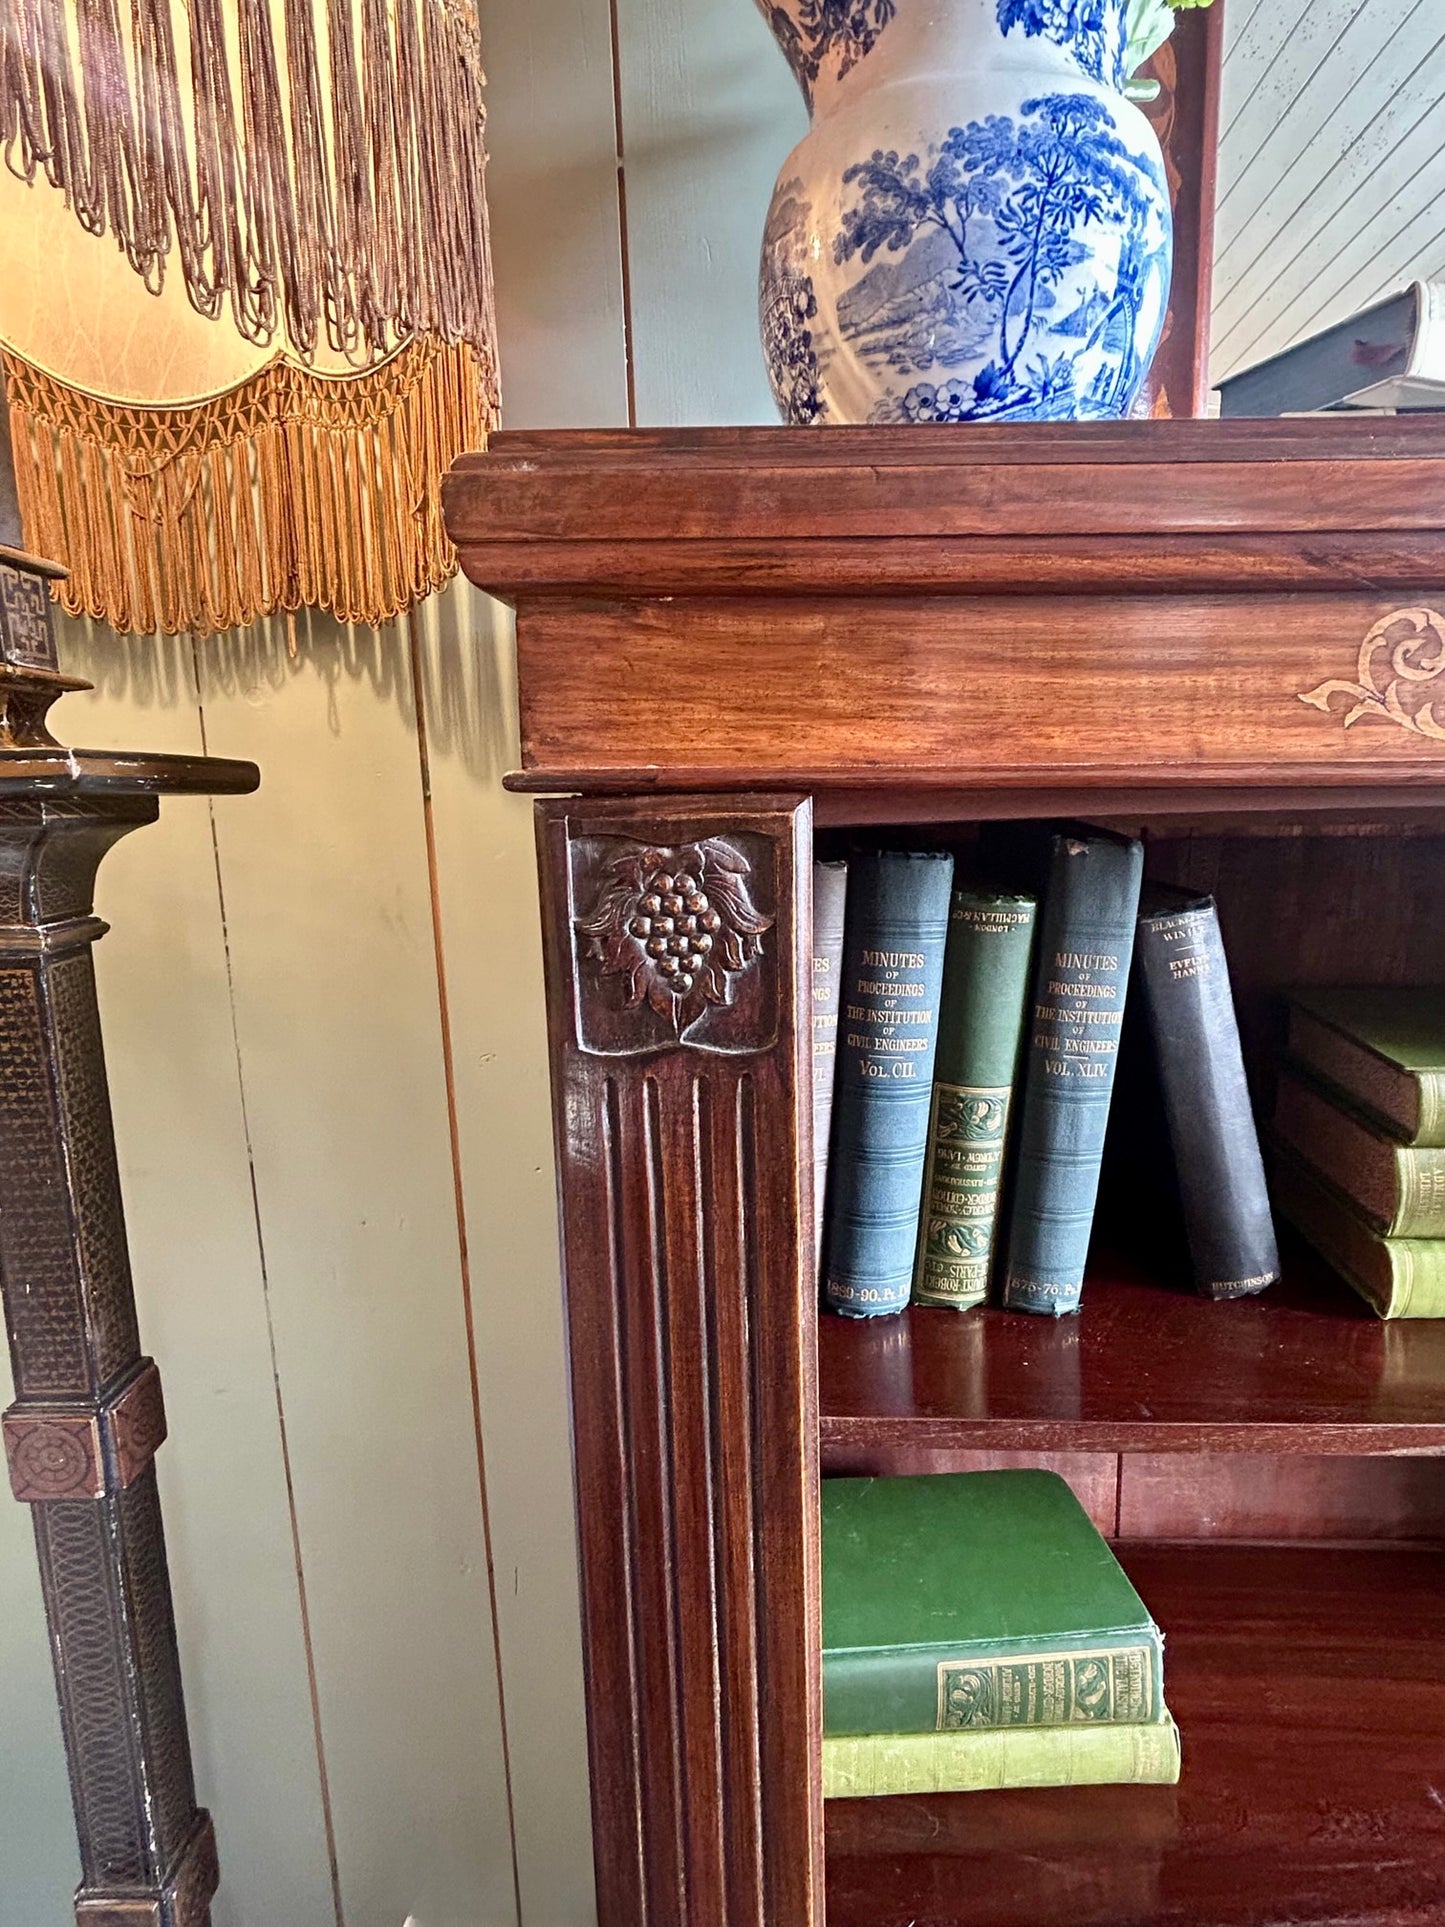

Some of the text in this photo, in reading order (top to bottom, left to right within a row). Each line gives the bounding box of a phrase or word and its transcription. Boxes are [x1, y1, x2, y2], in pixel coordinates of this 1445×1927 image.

[974, 924, 1009, 933] LONDON
[862, 950, 925, 968] MINUTES
[1055, 952, 1118, 971] MINUTES
[885, 971, 899, 979] OF
[1078, 973, 1092, 981] OF
[857, 980, 925, 997] PROCEEDINGS
[1048, 981, 1117, 998] PROCEEDINGS
[884, 1000, 898, 1008] OF
[1075, 1001, 1089, 1009] OF
[847, 1005, 932, 1024] THE INSTITUTION
[1035, 1005, 1123, 1025] THE INSTITUTION
[882, 1027, 896, 1035] OF
[1072, 1026, 1086, 1034] OF
[847, 1033, 872, 1049] CIVIL
[874, 1037, 929, 1052] ENGINEERS
[1034, 1034, 1119, 1053] CIVIL ENGINEERS
[1044, 1059, 1109, 1078] VOL. XLIV.
[949, 1265, 978, 1279] PARIS
